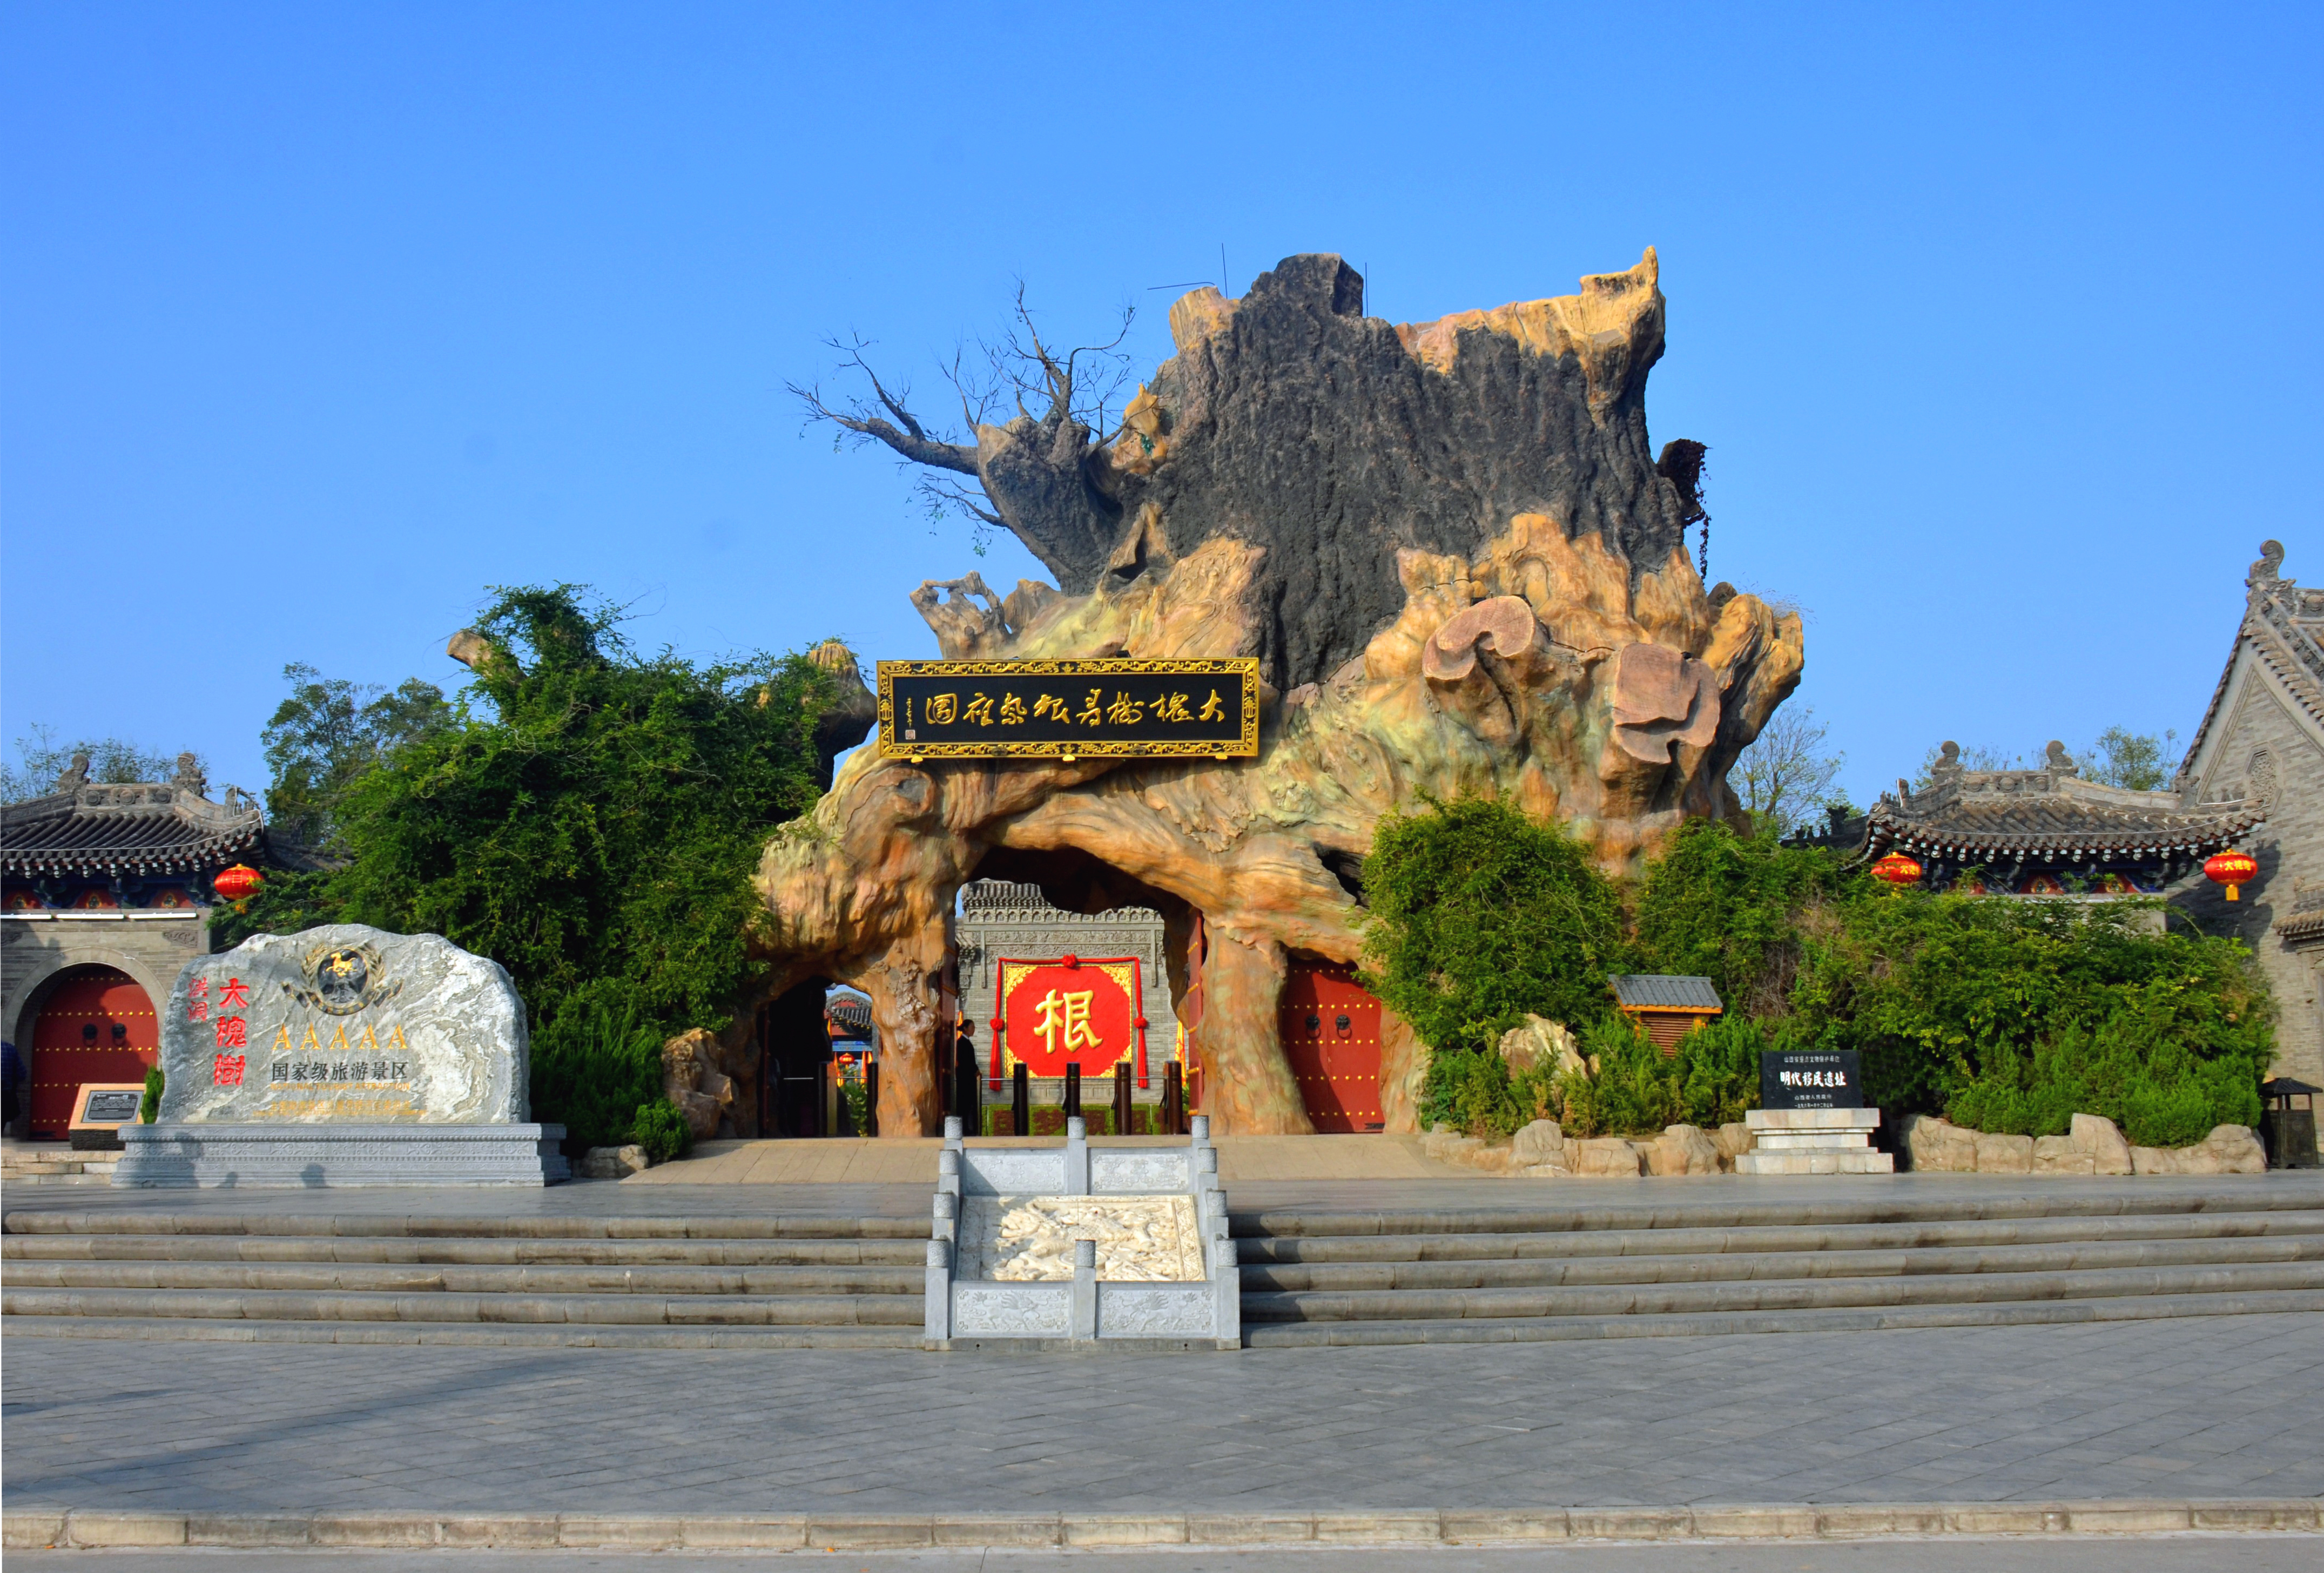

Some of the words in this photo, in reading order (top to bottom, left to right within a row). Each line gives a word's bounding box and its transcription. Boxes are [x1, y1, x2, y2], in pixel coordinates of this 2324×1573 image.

[187, 977, 208, 1022] 洪洞
[1034, 989, 1103, 1054] 根
[214, 978, 249, 1086] 大槐樹
[272, 1062, 408, 1082] 国家级旅游景区
[355, 1082, 410, 1090] ATTRACTION
